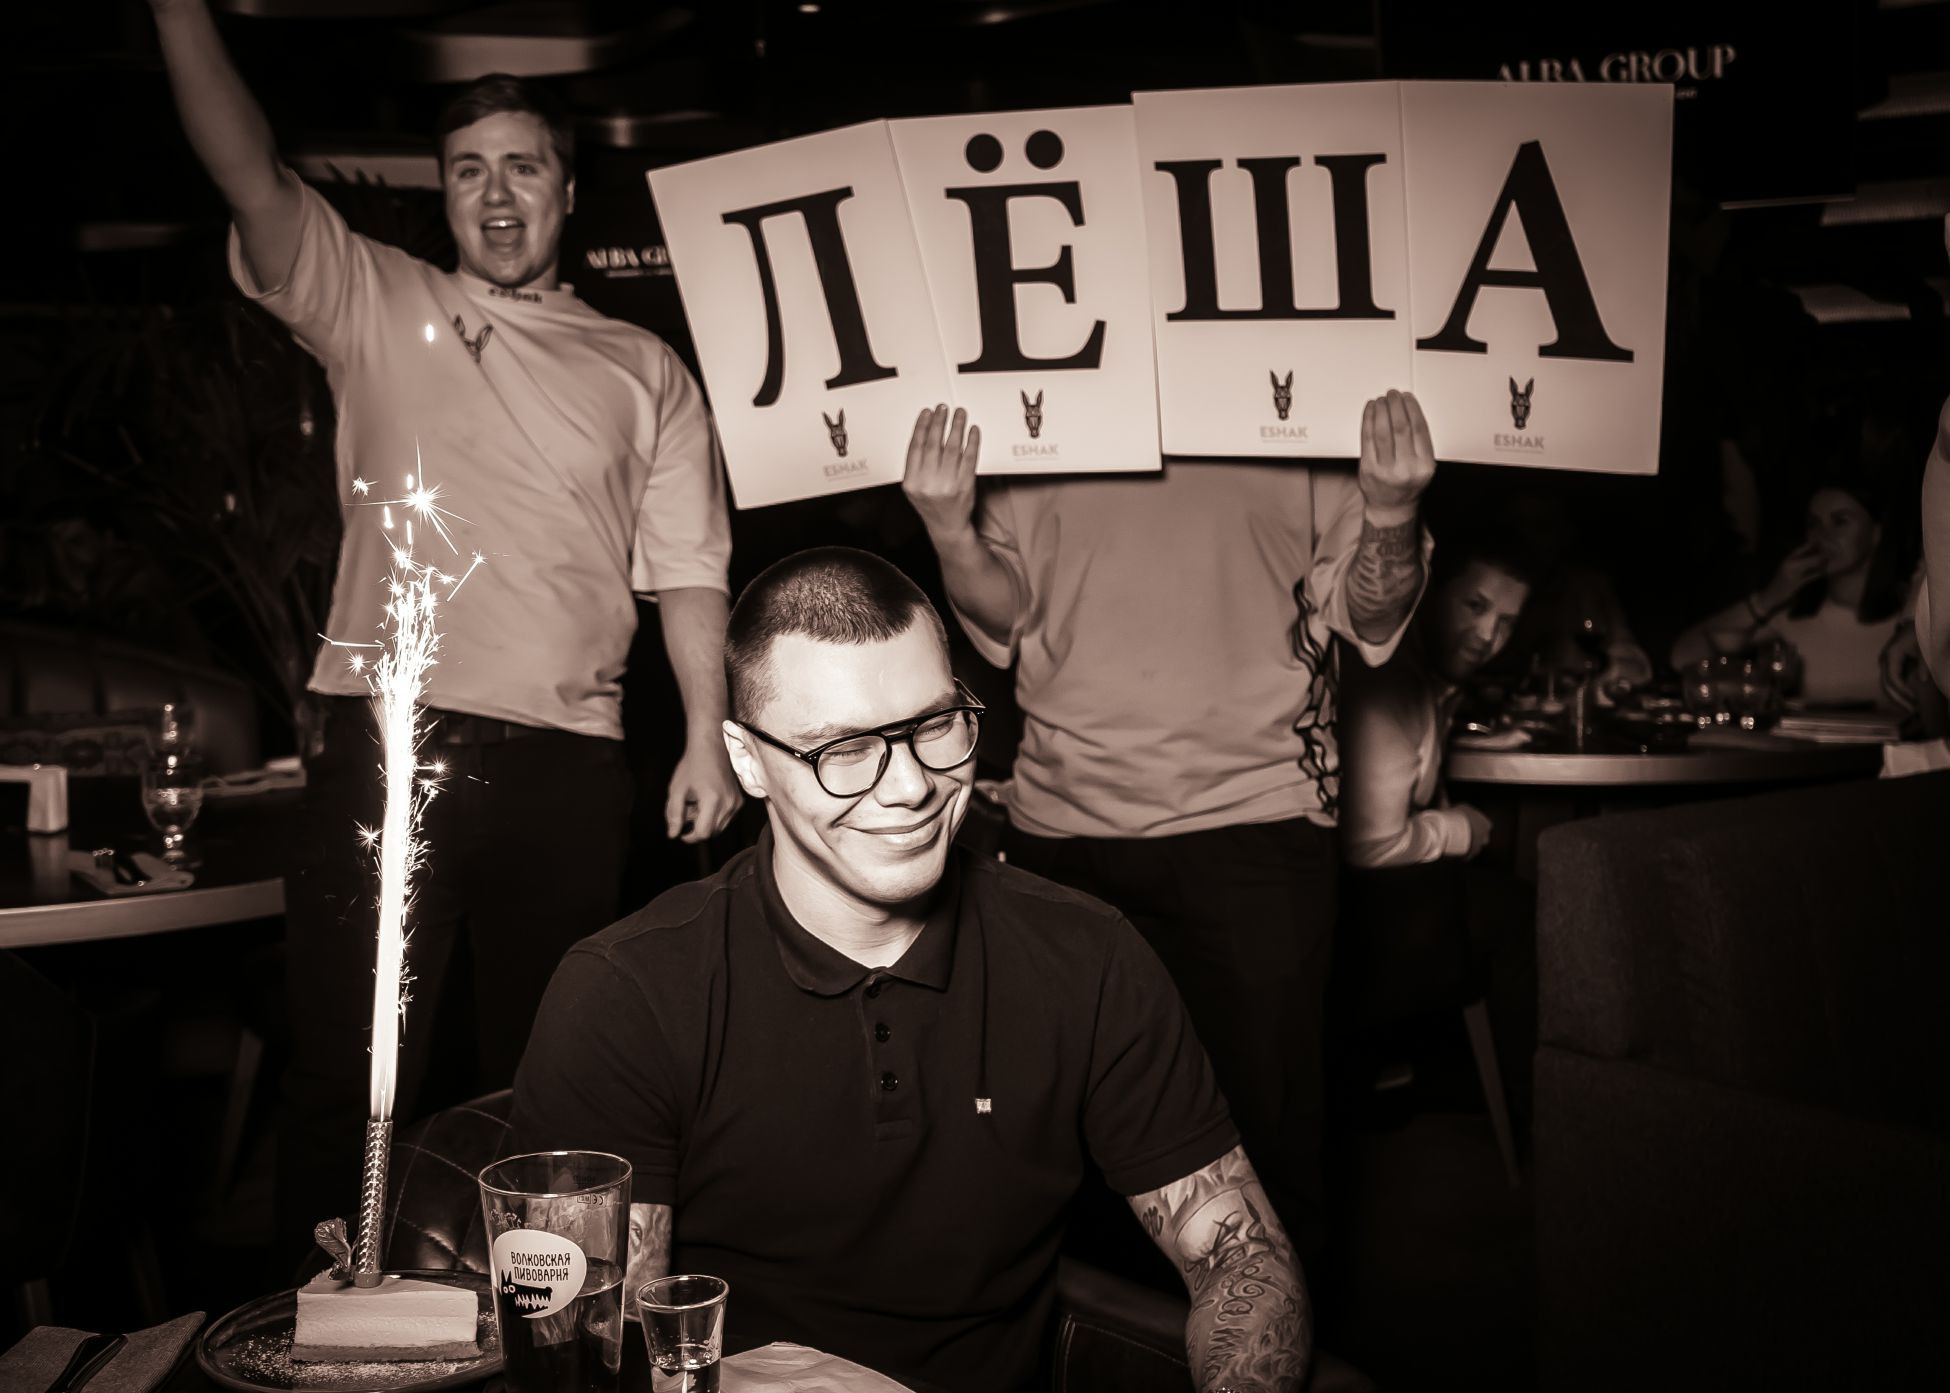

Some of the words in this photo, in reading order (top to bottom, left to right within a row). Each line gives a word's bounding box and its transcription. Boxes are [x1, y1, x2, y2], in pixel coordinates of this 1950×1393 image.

[1600, 45, 1737, 82] GROUP
[722, 130, 1634, 407] ЛЁША
[1259, 425, 1309, 439] ESHAK
[1493, 434, 1545, 450] ESHAK
[1011, 444, 1059, 457] ESHAK
[822, 459, 869, 477] ESHAK
[510, 1251, 571, 1267] ВОЛКОВСКАЯ
[514, 1266, 569, 1281] ПИВОВАРНЯ
